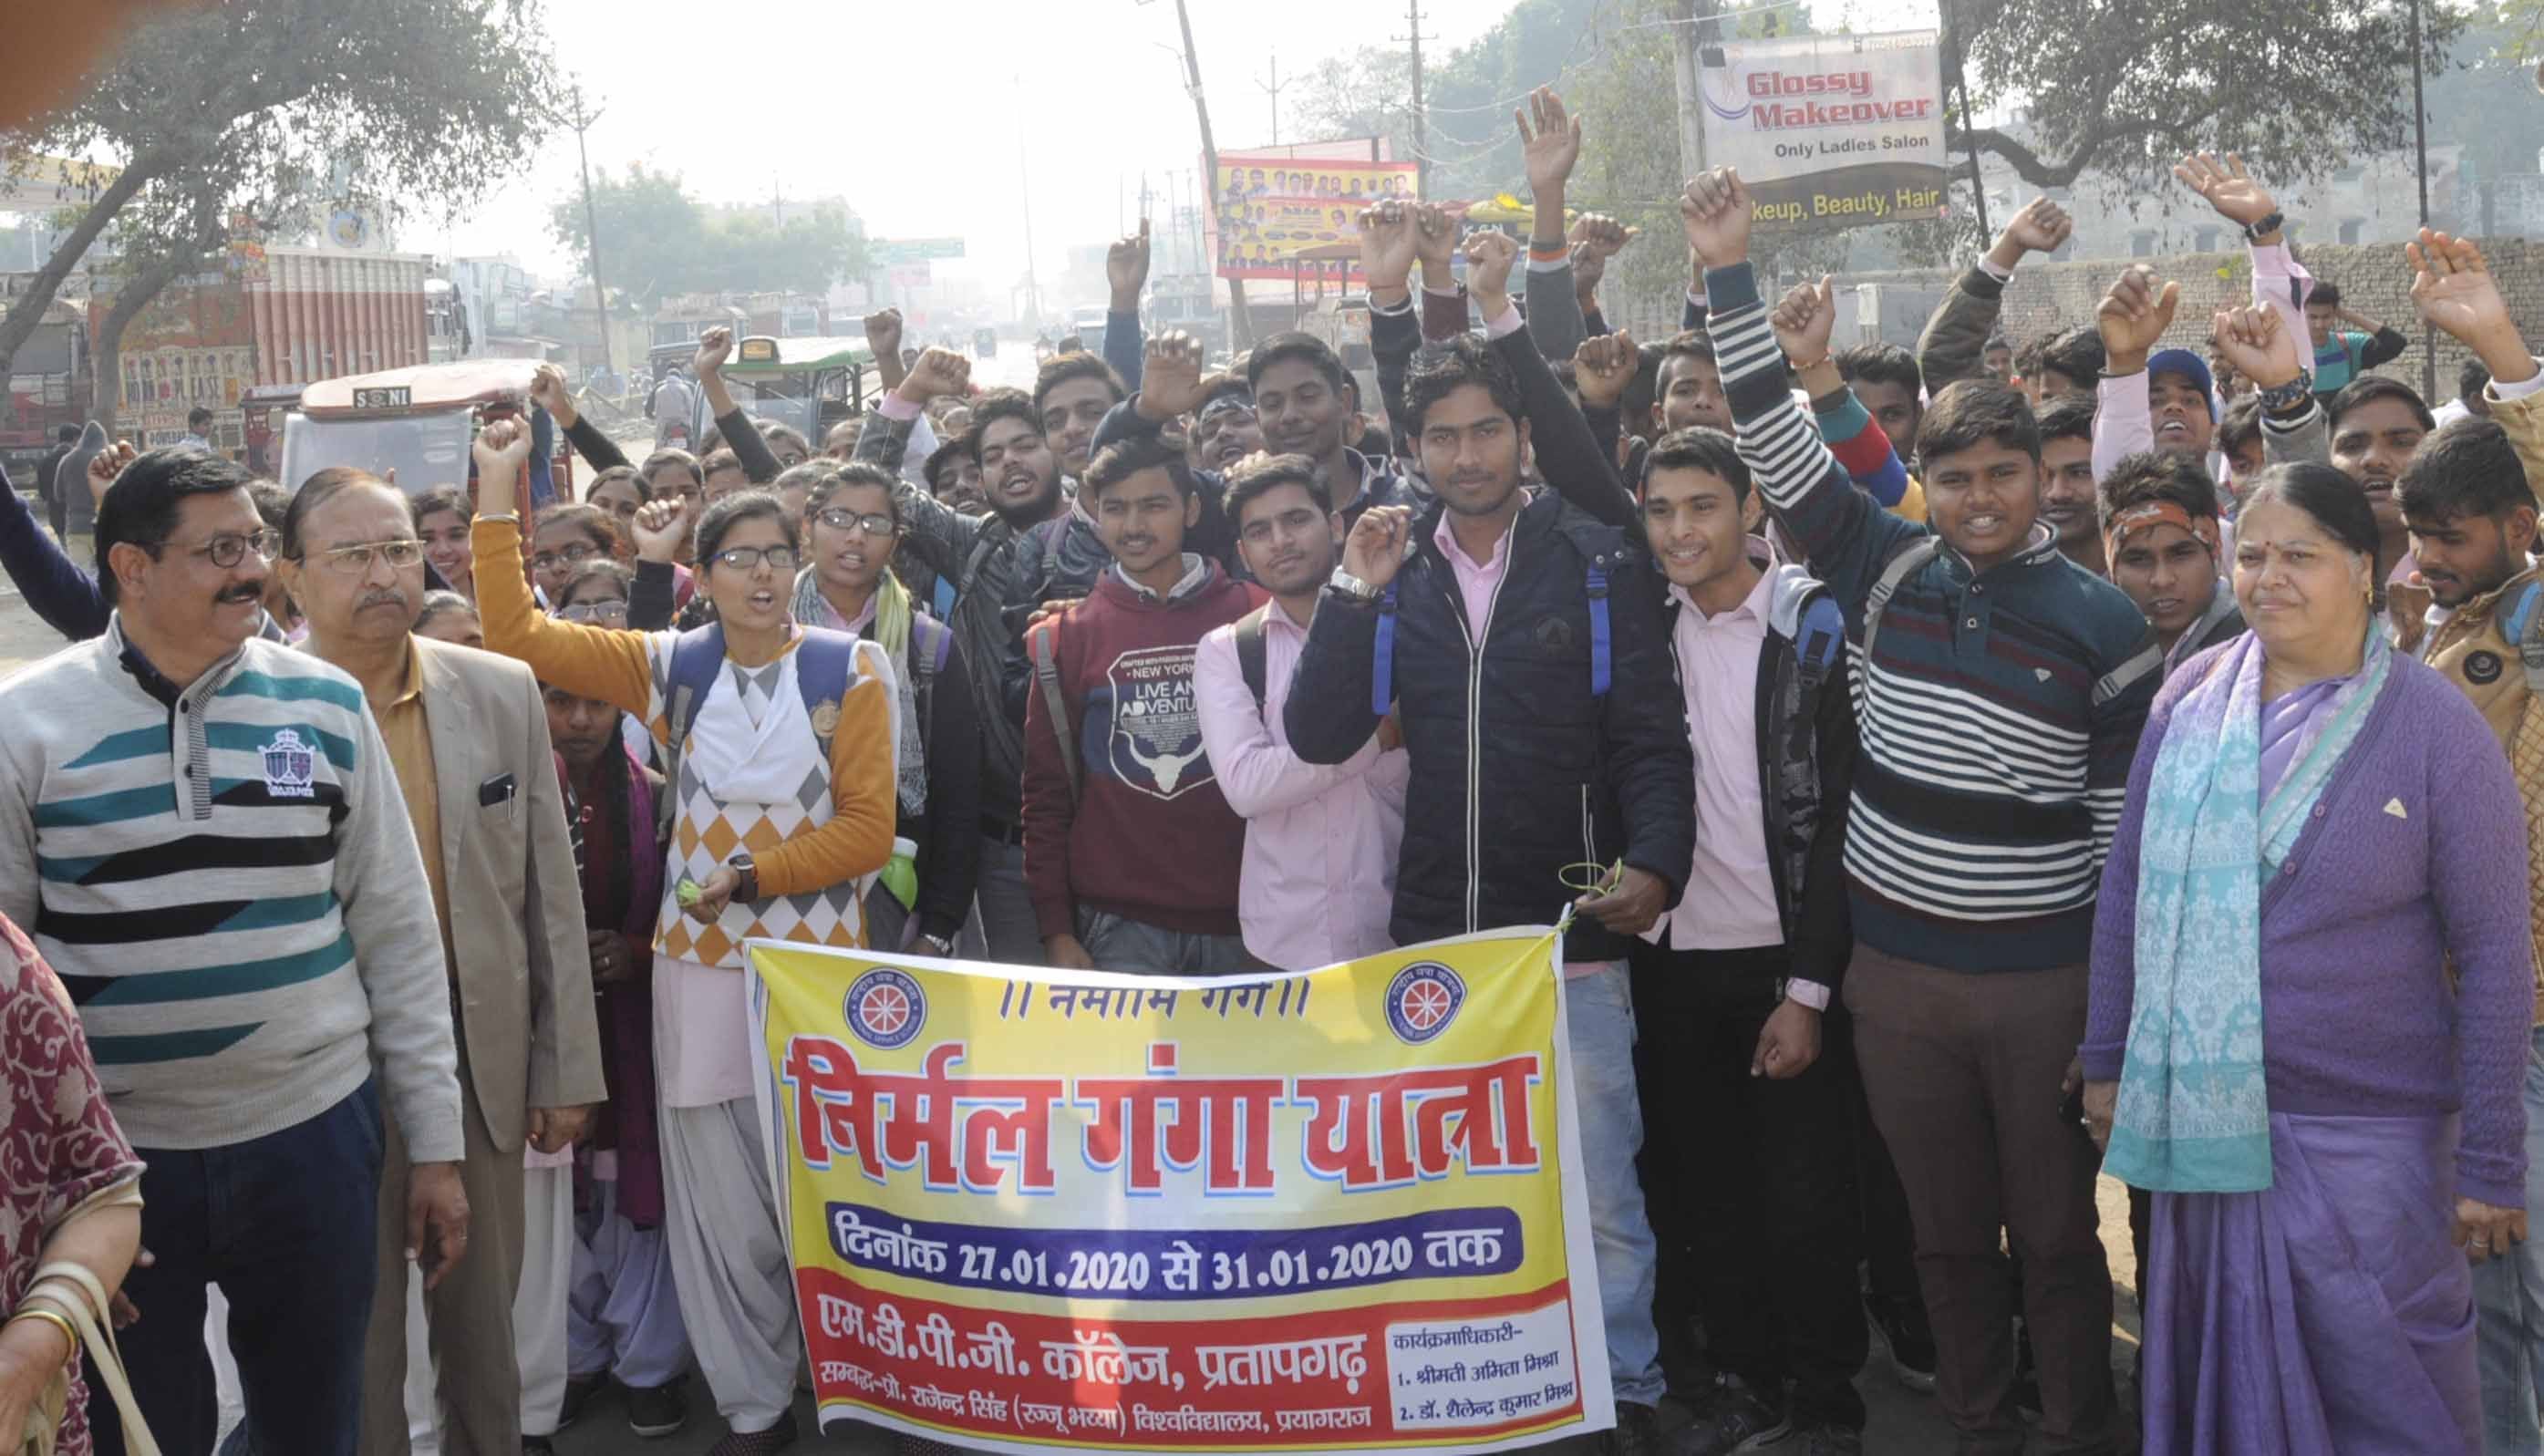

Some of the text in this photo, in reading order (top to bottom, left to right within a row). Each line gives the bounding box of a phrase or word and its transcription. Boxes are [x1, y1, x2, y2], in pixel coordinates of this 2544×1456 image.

[1746, 70, 1874, 99] Glossy
[1751, 98, 1933, 132] Makeover
[1774, 134, 1930, 160] Only Ladies Salon
[1751, 186, 1941, 223] keup, Beauty, Hair
[1132, 666, 1162, 679] NEW
[1135, 681, 1172, 700] LIVE
[1120, 697, 1197, 717] ADVENTU
[784, 1036, 1541, 1193] निर्मल गंगा यात्रा
[834, 1210, 1505, 1291] दिनांक 27.01.2020 से 31.01.2020 तक
[817, 1293, 1368, 1396] एम.डी.पी.जी. कॉलेज, प्रतापगढ़
[1416, 1361, 1466, 1385] श्रीमती
[1471, 1359, 1521, 1382] अमिता
[1524, 1349, 1560, 1374] मिश्रा
[910, 1383, 966, 1415] राजेन्द्र
[968, 1389, 1008, 1421] सिंह
[1132, 1403, 1270, 1433] विश्वविद्यालय,
[1275, 1406, 1372, 1433] प्रयागराज
[1419, 1399, 1442, 1420] डॉ.
[1445, 1397, 1495, 1419] शैलेन्द्र
[1498, 1390, 1543, 1417] कुमार
[1544, 1380, 1575, 1404] मिश्र
